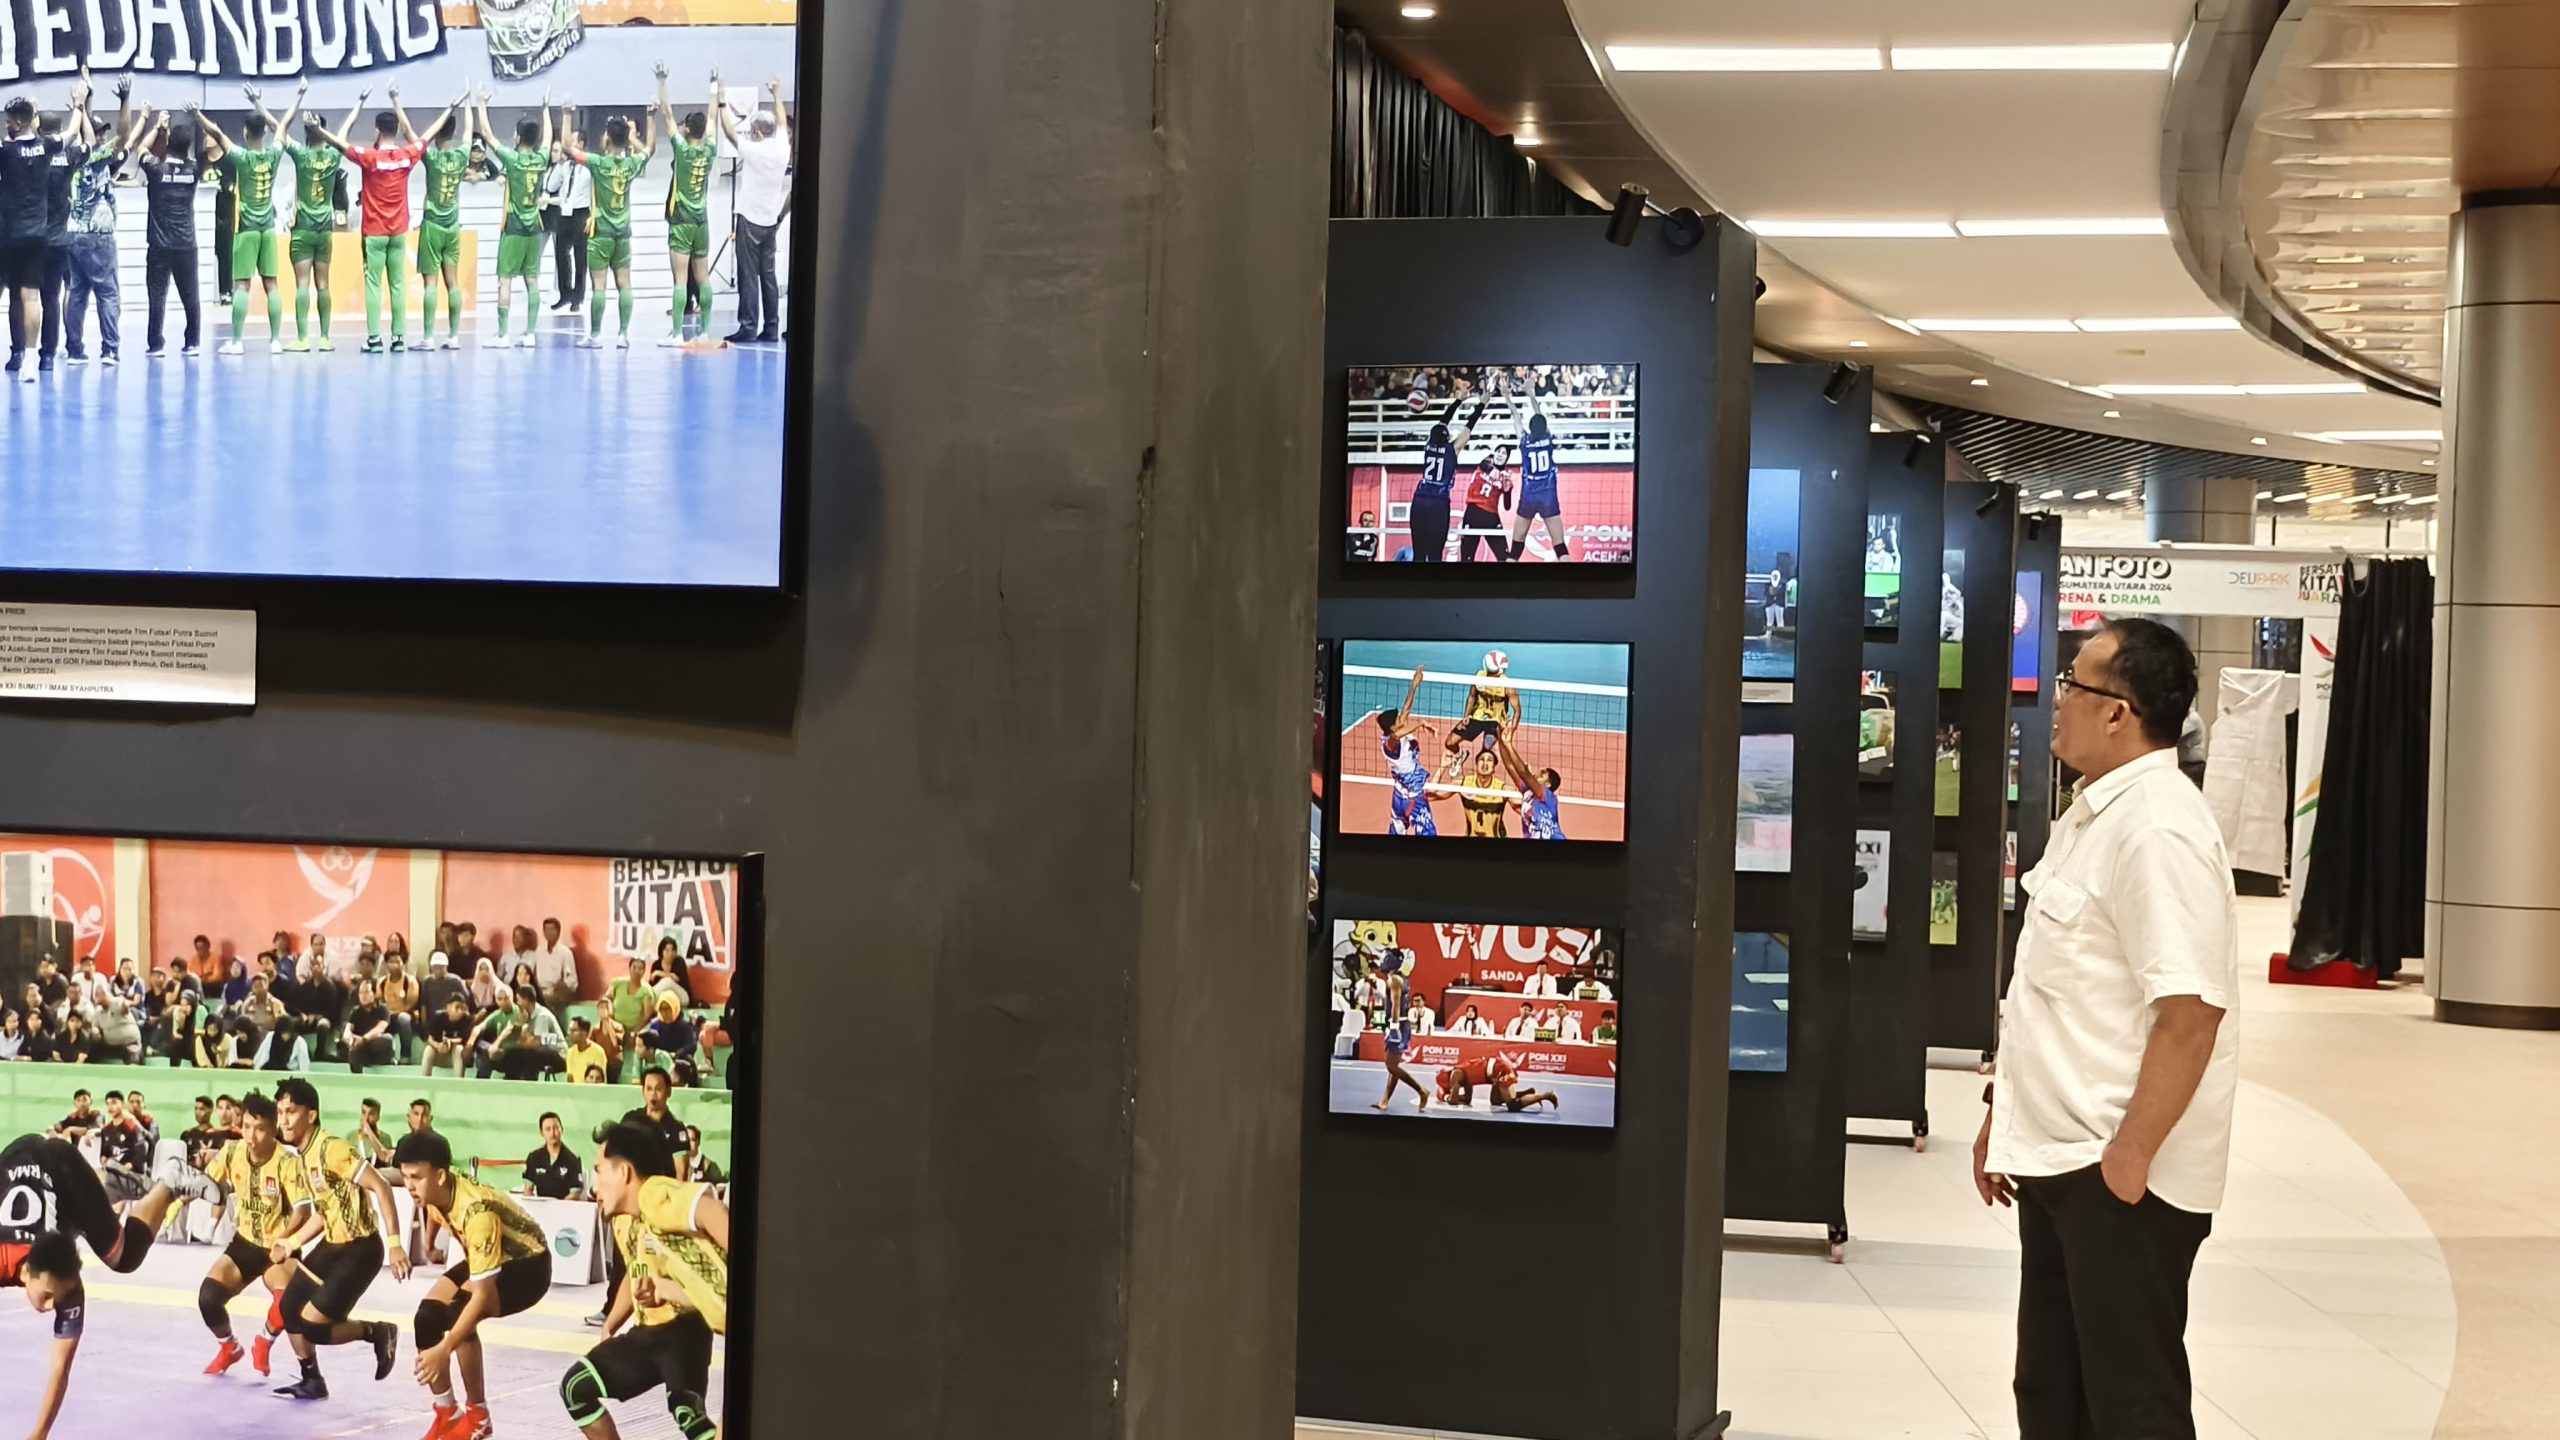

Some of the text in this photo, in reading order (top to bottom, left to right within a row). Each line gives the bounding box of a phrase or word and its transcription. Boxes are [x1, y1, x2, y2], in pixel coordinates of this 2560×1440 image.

[0, 0, 440, 80] EDANBUNG
[1528, 450, 1550, 473] 10
[1424, 456, 1445, 481] 21
[1582, 524, 1628, 542] PON
[2098, 553, 2172, 580] FOTO
[2059, 581, 2173, 592] SUMATERA UTARA 2024
[2098, 593, 2107, 603] &
[2110, 593, 2161, 605] DRAMA
[28, 656, 54, 664] Jakarta
[63, 657, 79, 665] GOR
[69, 684, 114, 693] SYAHPUTRA
[1480, 969, 1525, 982] SANDA
[1422, 1045, 1460, 1057] PON XXI
[1528, 1051, 1567, 1063] PON XXI
